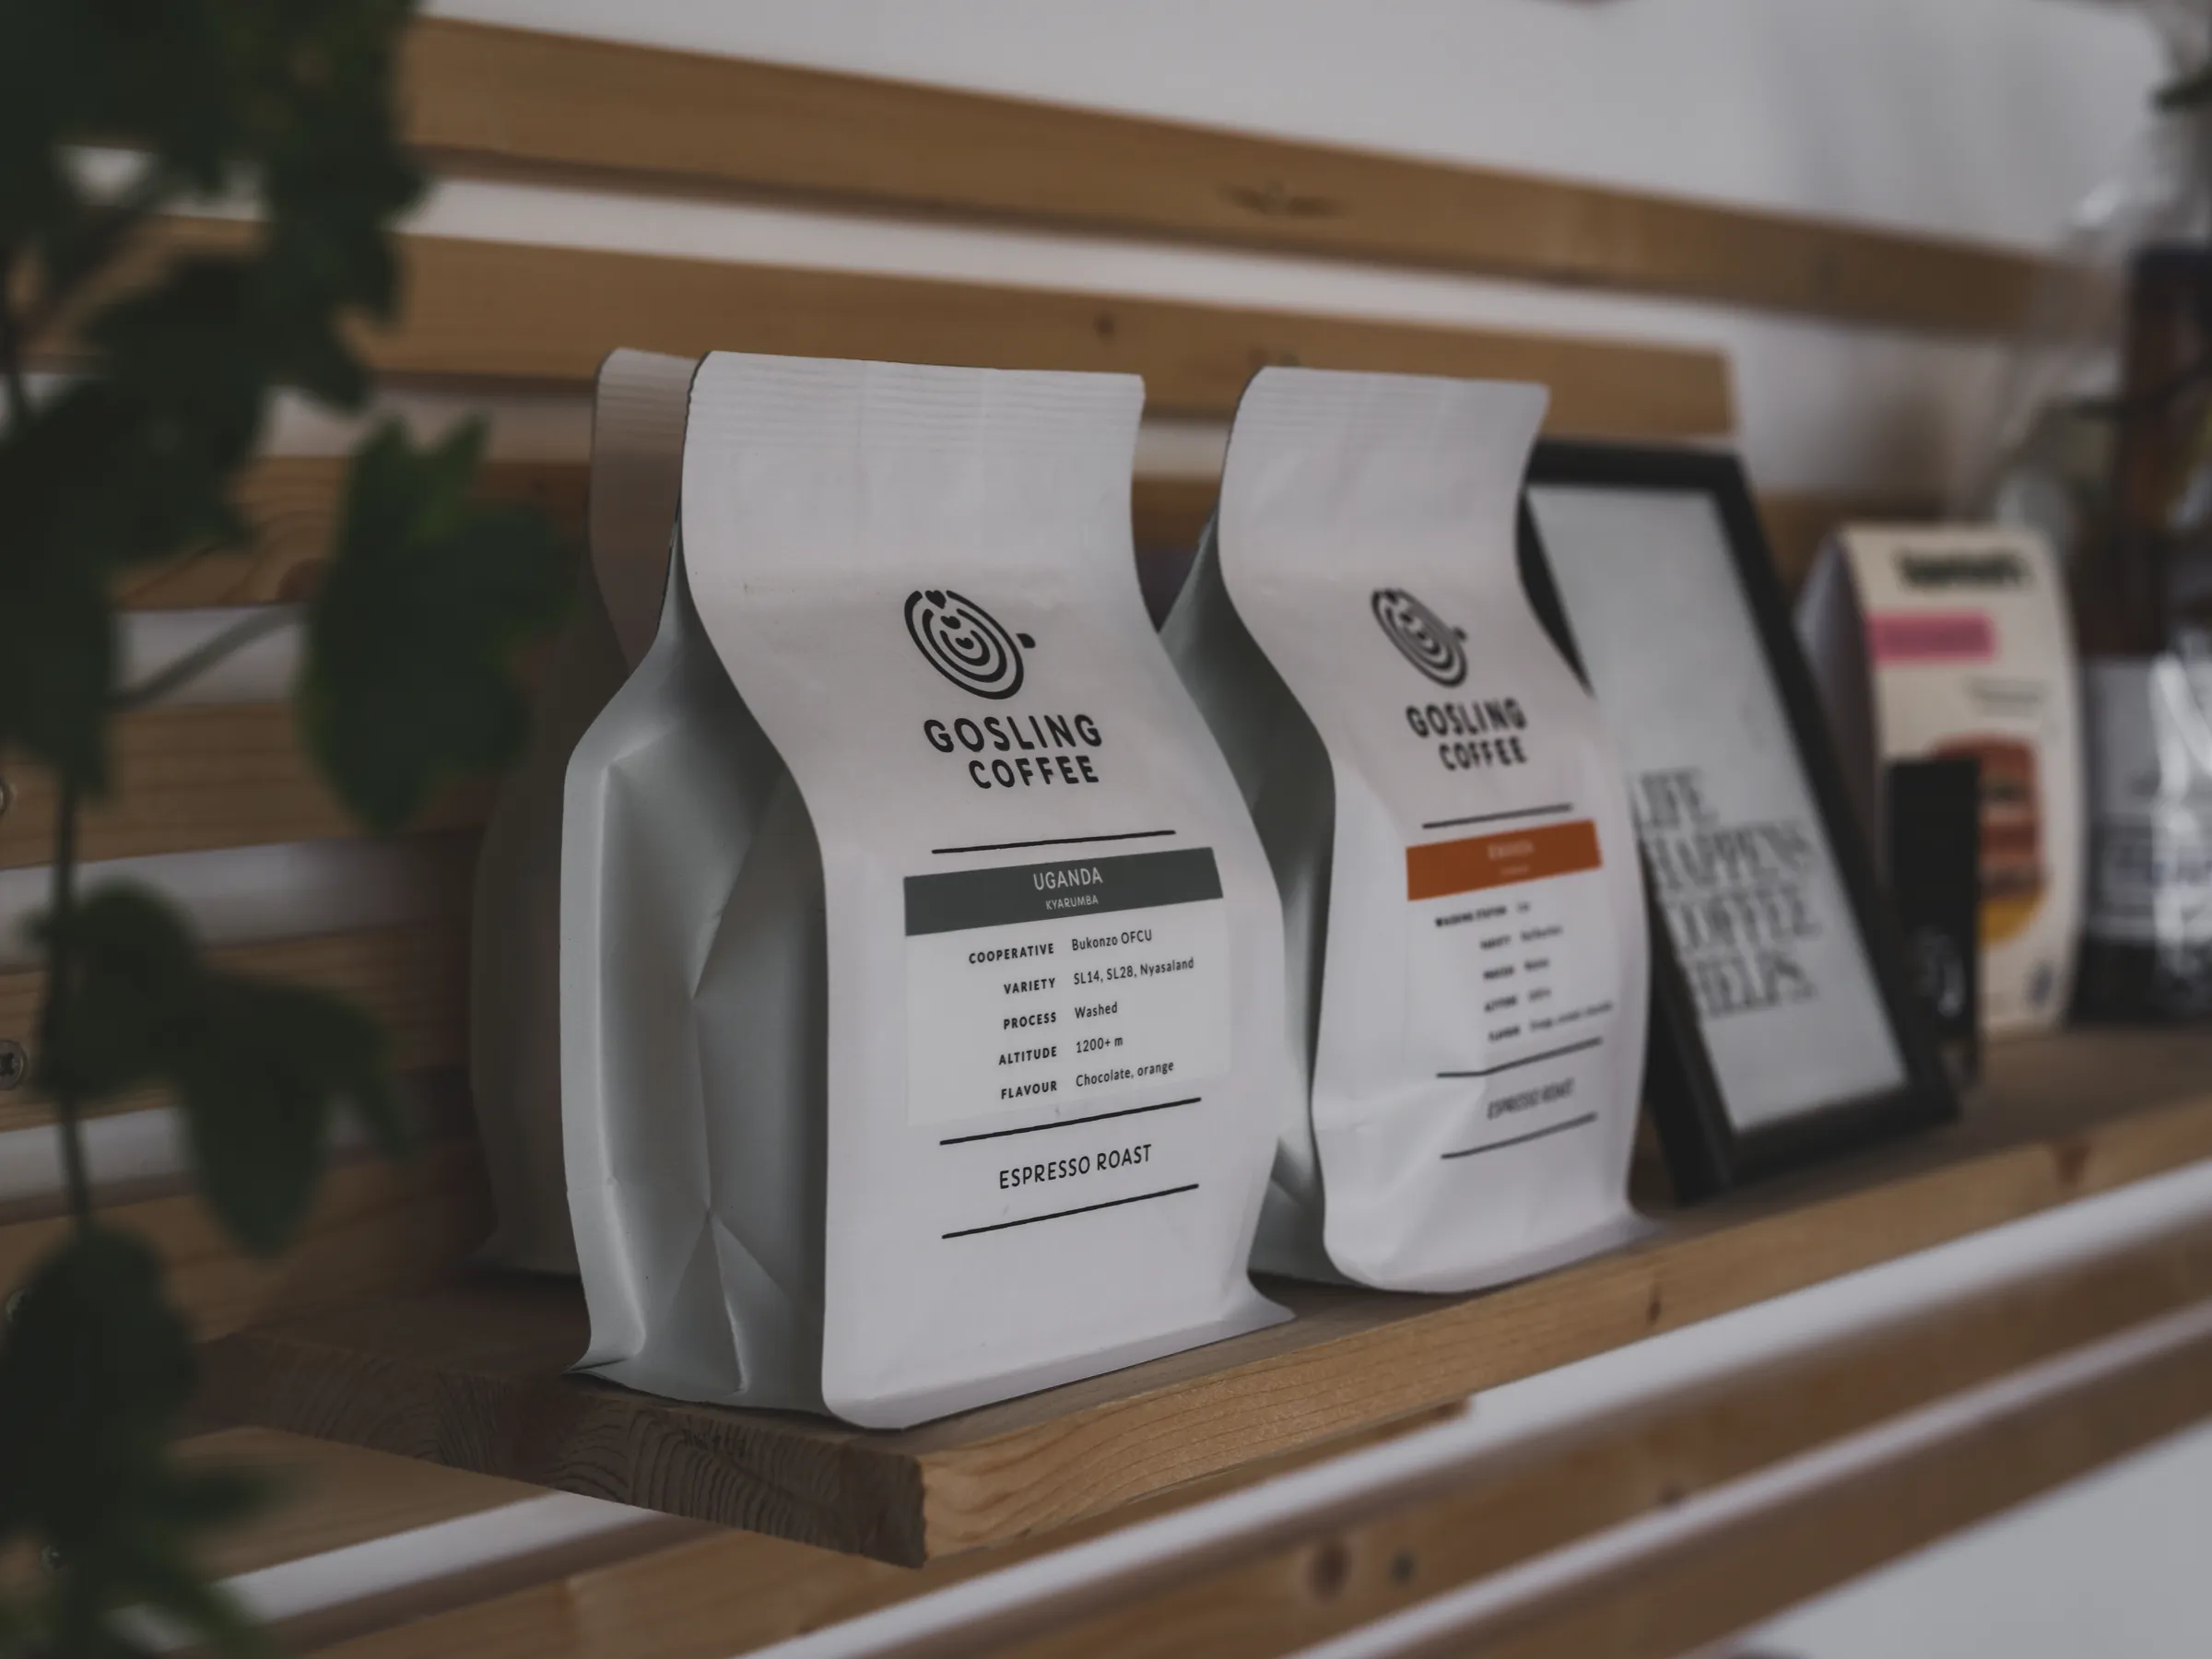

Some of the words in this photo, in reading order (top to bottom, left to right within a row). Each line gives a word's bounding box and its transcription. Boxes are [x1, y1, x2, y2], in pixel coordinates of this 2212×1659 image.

[924, 714, 1102, 753] GOSLING
[1406, 697, 1527, 739] GOSLING
[1439, 735, 1527, 771] COFFEE
[969, 755, 1100, 789] COFFEE
[1032, 866, 1103, 891] UGANDA
[1045, 894, 1100, 911] KYARUMBA
[969, 942, 1054, 965] COOPERATIVE
[1072, 935, 1119, 952] Bukonzo
[1121, 928, 1153, 946] OFCU
[1004, 977, 1056, 995] VARIETY
[1073, 970, 1104, 986] SL14,
[1106, 965, 1137, 982] SL28,
[1140, 956, 1194, 977] Nyasaland
[1003, 1011, 1057, 1030] PROCESS
[1075, 1001, 1119, 1020] Washed
[999, 1045, 1058, 1066] ALTITUDE
[1076, 1037, 1112, 1053] 1200+
[1114, 1036, 1124, 1047] m
[1001, 1079, 1058, 1100] FLAVOUR
[1076, 1067, 1135, 1088] Chocolate,
[1137, 1060, 1174, 1077] orange
[999, 1155, 1091, 1190] ESPRESSO
[1097, 1143, 1153, 1171] ROAST
